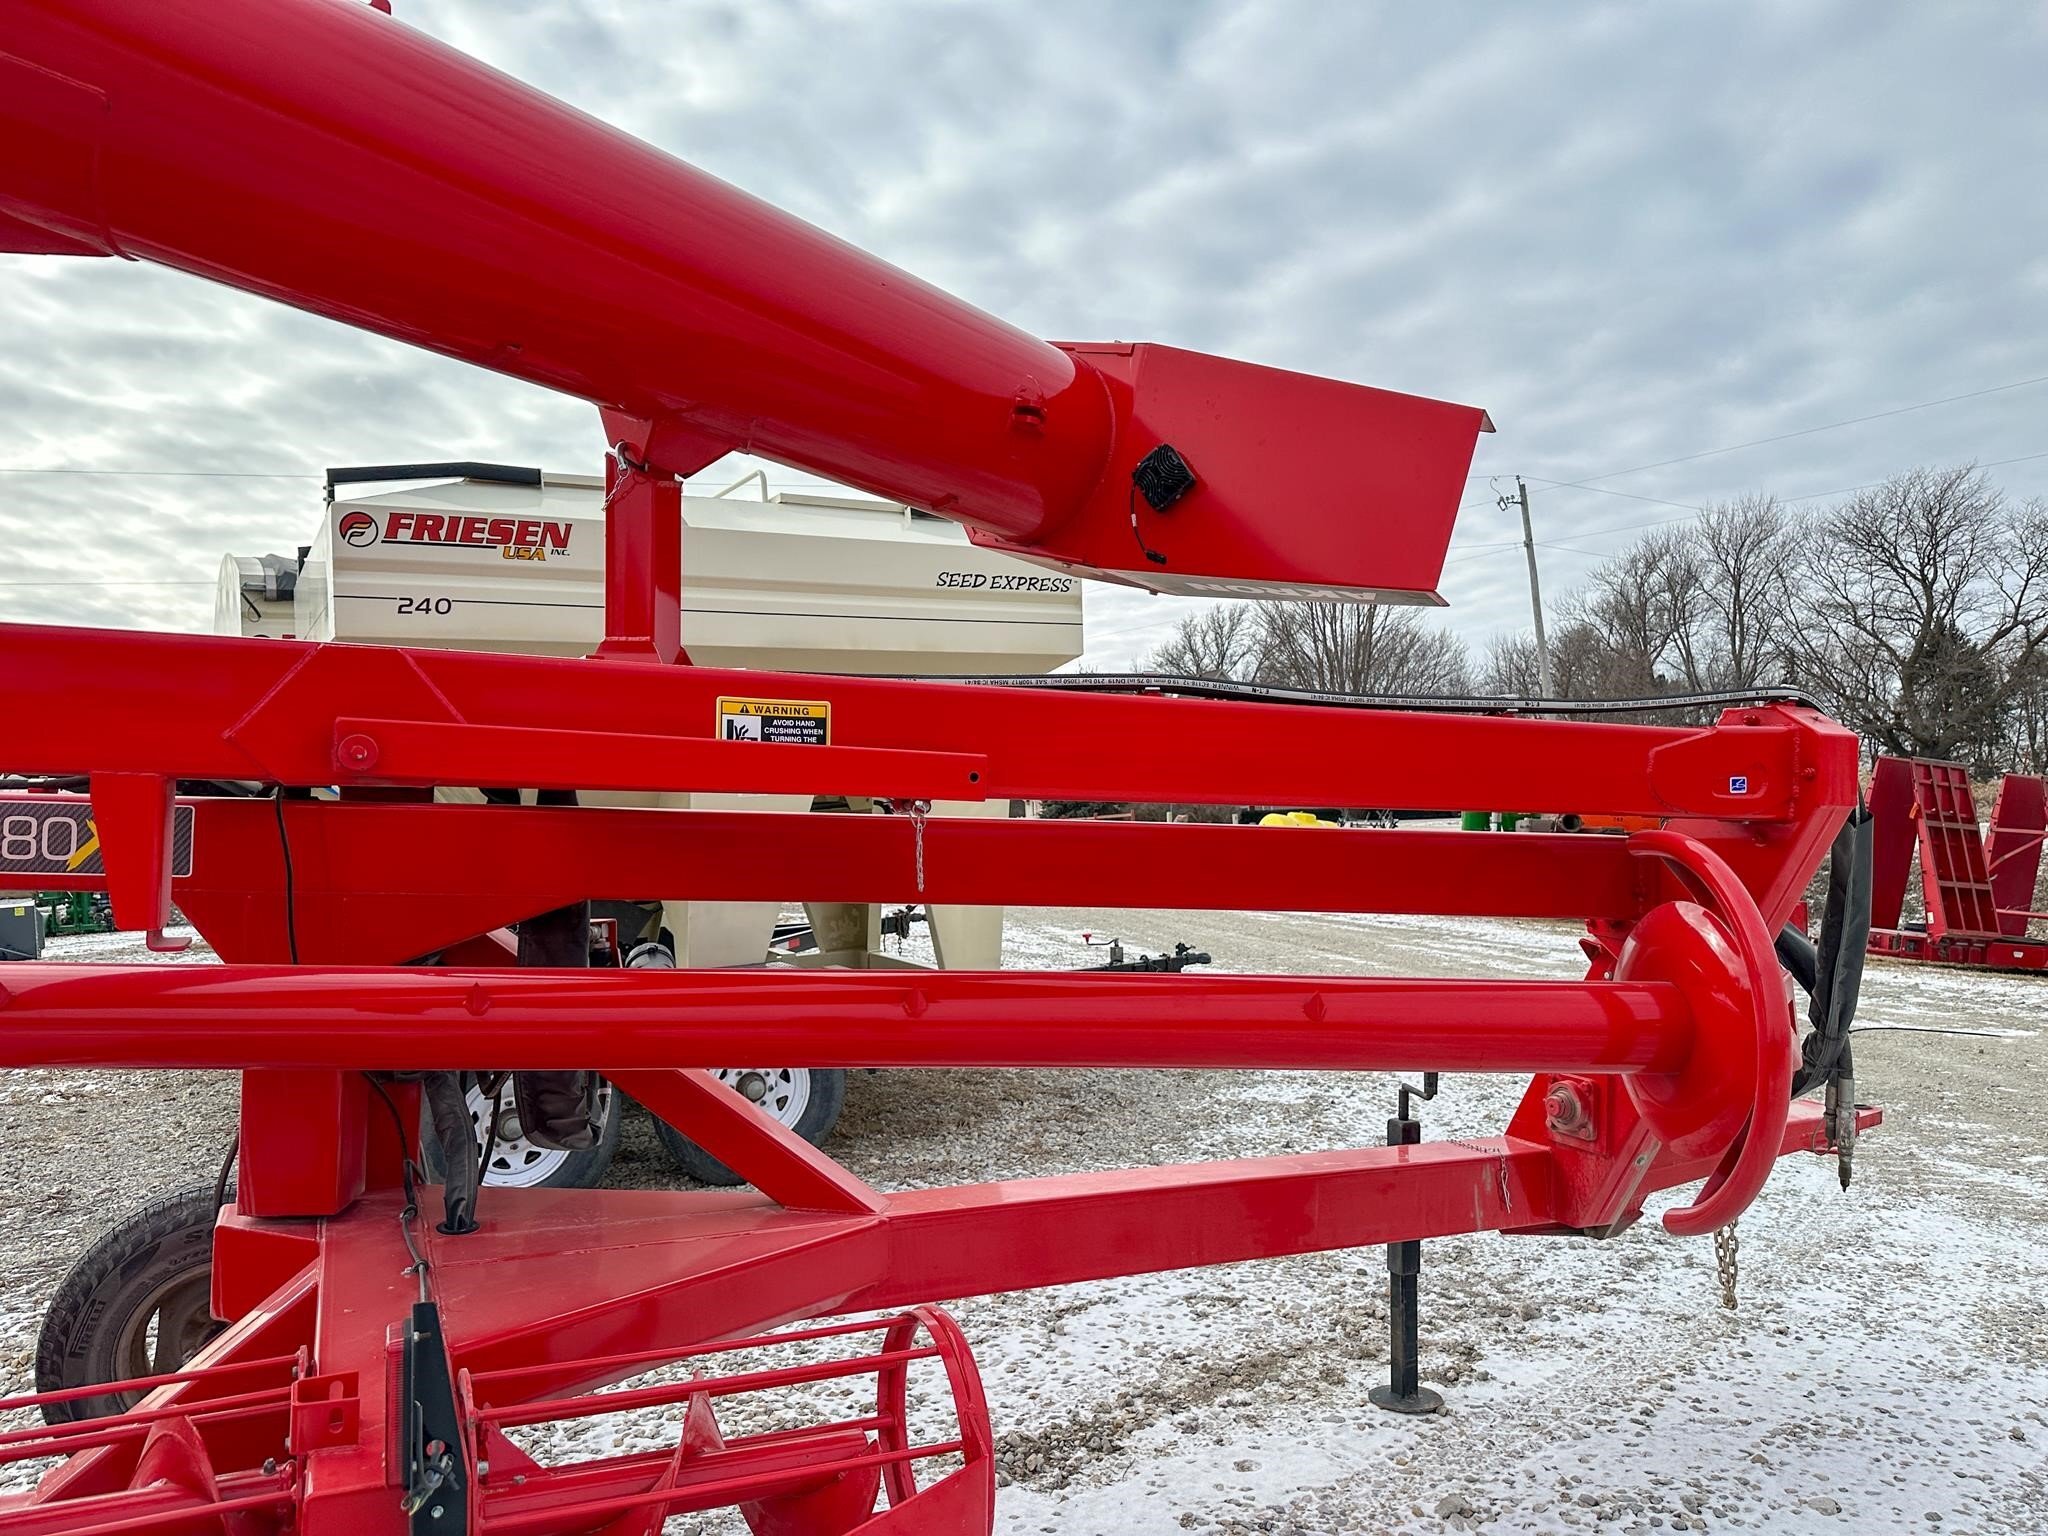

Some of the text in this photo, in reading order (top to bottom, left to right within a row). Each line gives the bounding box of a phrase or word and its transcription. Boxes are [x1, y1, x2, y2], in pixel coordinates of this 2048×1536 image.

[384, 512, 573, 549] FRIESEN
[502, 546, 571, 562] USA INC.
[936, 572, 1073, 593] SEED EXPRESS
[1185, 582, 1377, 600] AKRON
[397, 597, 452, 615] 240
[754, 705, 809, 716] WARNING
[764, 727, 824, 736] CRUSHING WHEN
[772, 719, 794, 727] AVOID
[770, 735, 818, 744] TURNING THE
[68, 1297, 107, 1360] PIRELLI
